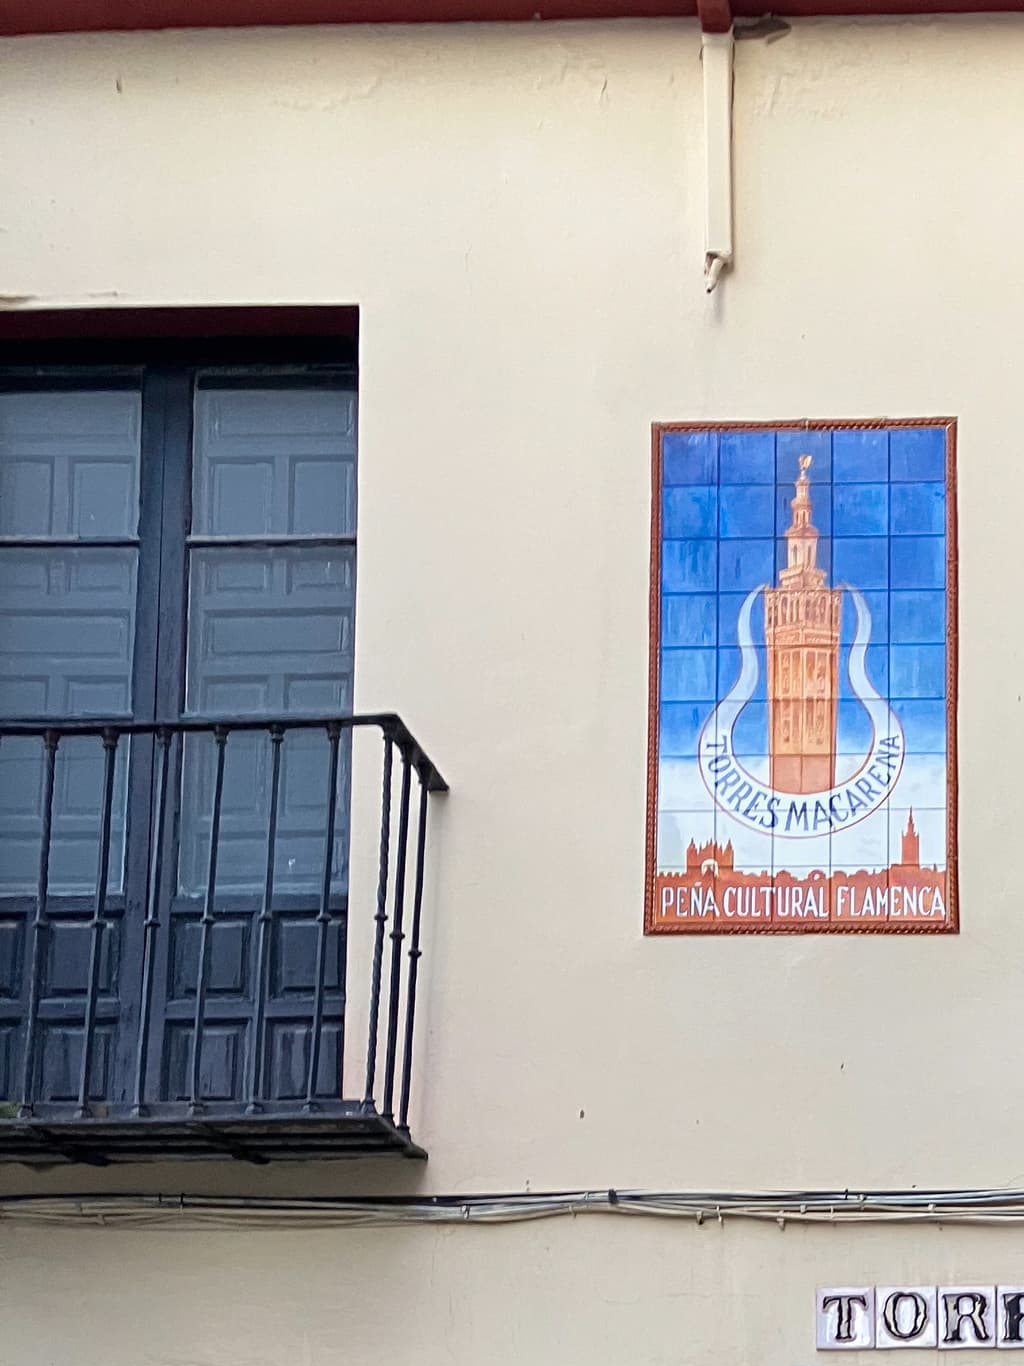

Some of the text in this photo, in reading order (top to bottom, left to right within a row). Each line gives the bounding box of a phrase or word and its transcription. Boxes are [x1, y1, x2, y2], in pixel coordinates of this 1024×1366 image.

[705, 735, 900, 831] TORRES MACARENA
[661, 882, 946, 918] PEÑA CULTURAL FLAMENCA
